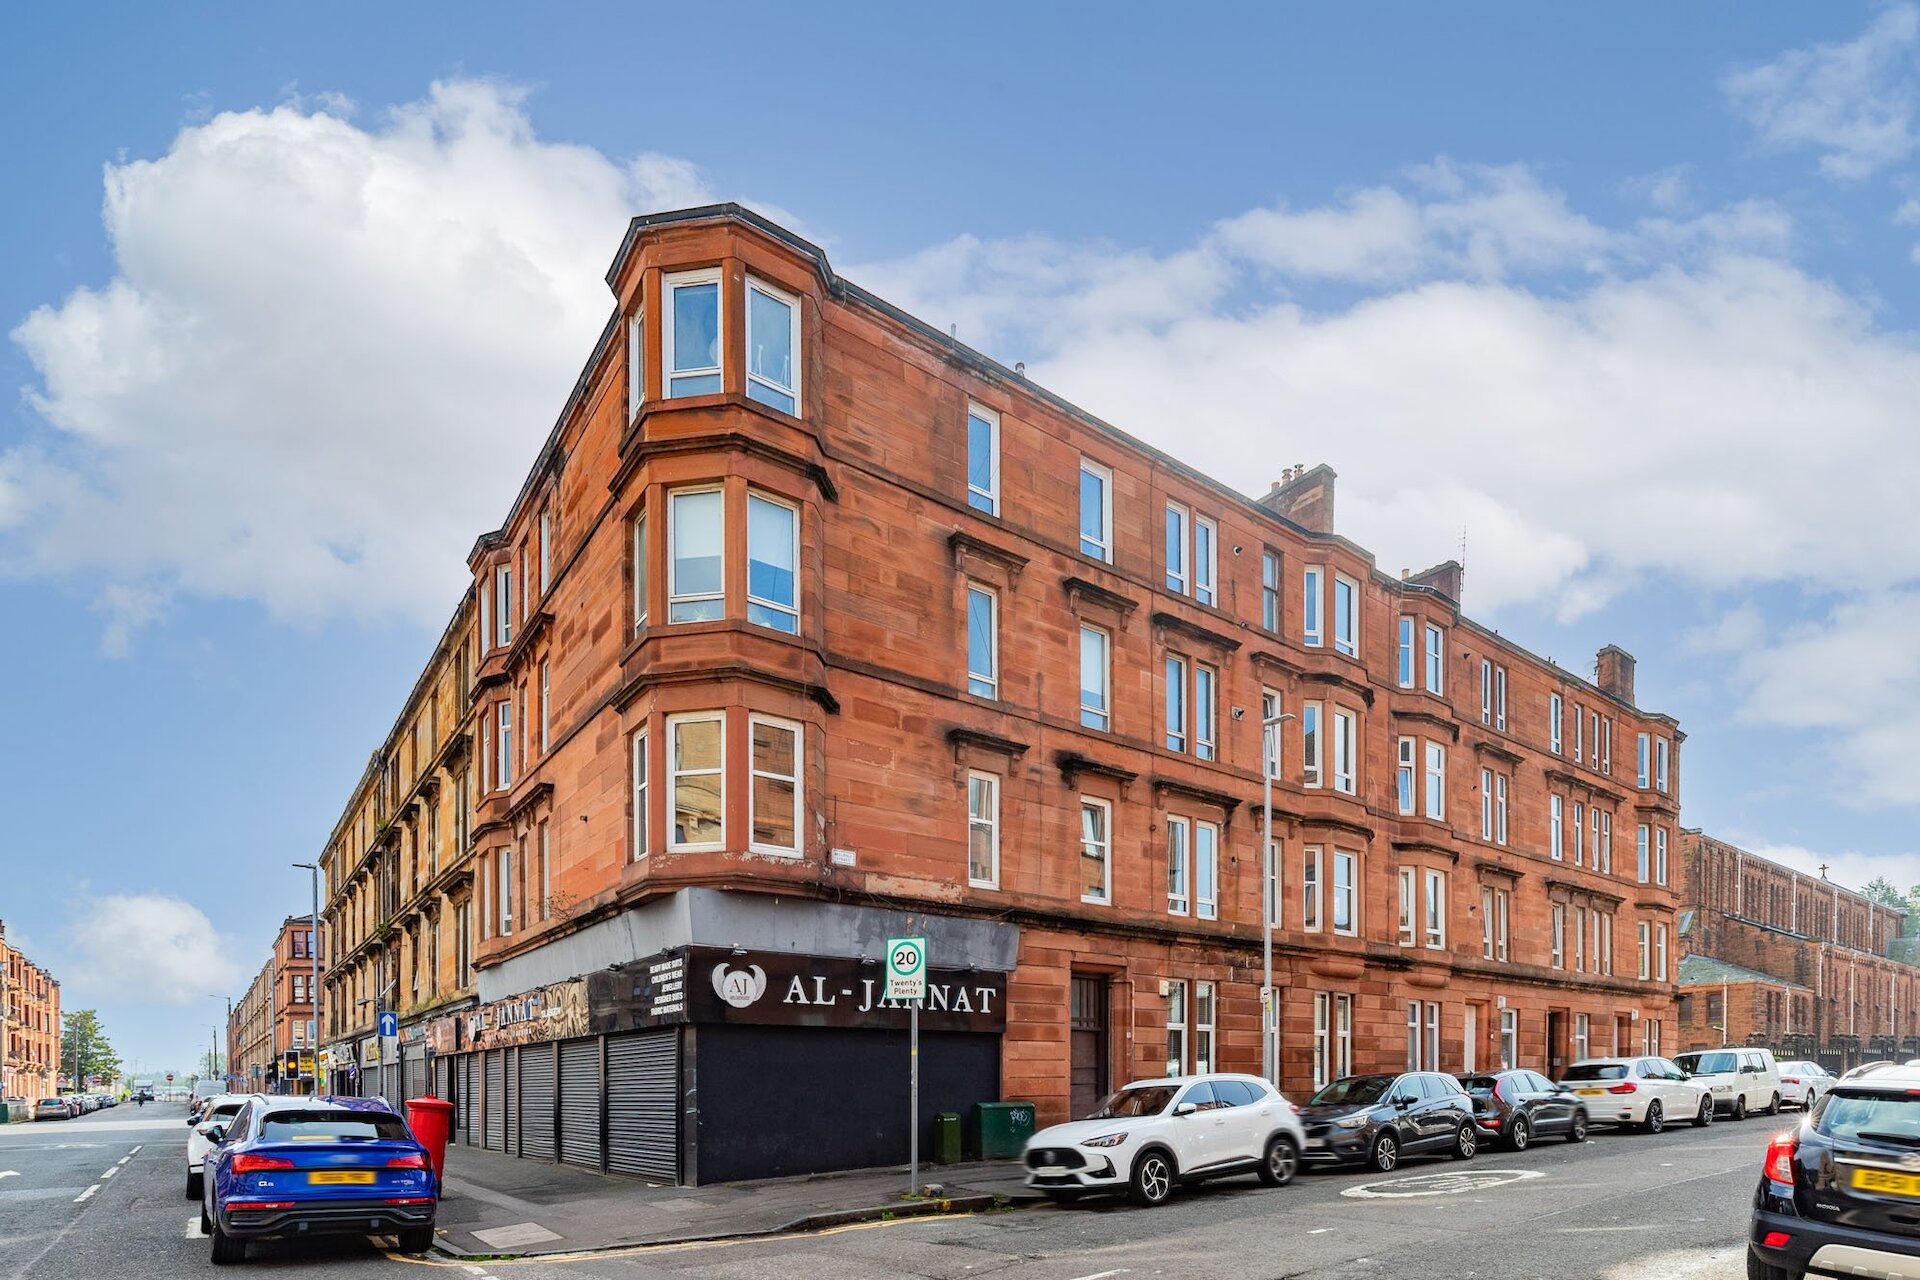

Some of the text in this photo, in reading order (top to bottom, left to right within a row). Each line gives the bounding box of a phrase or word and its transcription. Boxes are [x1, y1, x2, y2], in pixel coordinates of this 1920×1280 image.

[896, 951, 917, 965] 20
[662, 981, 683, 993] JEWELLERY
[729, 978, 748, 996] AJ
[890, 979, 922, 987] Twenty's
[894, 987, 917, 995] Plenty
